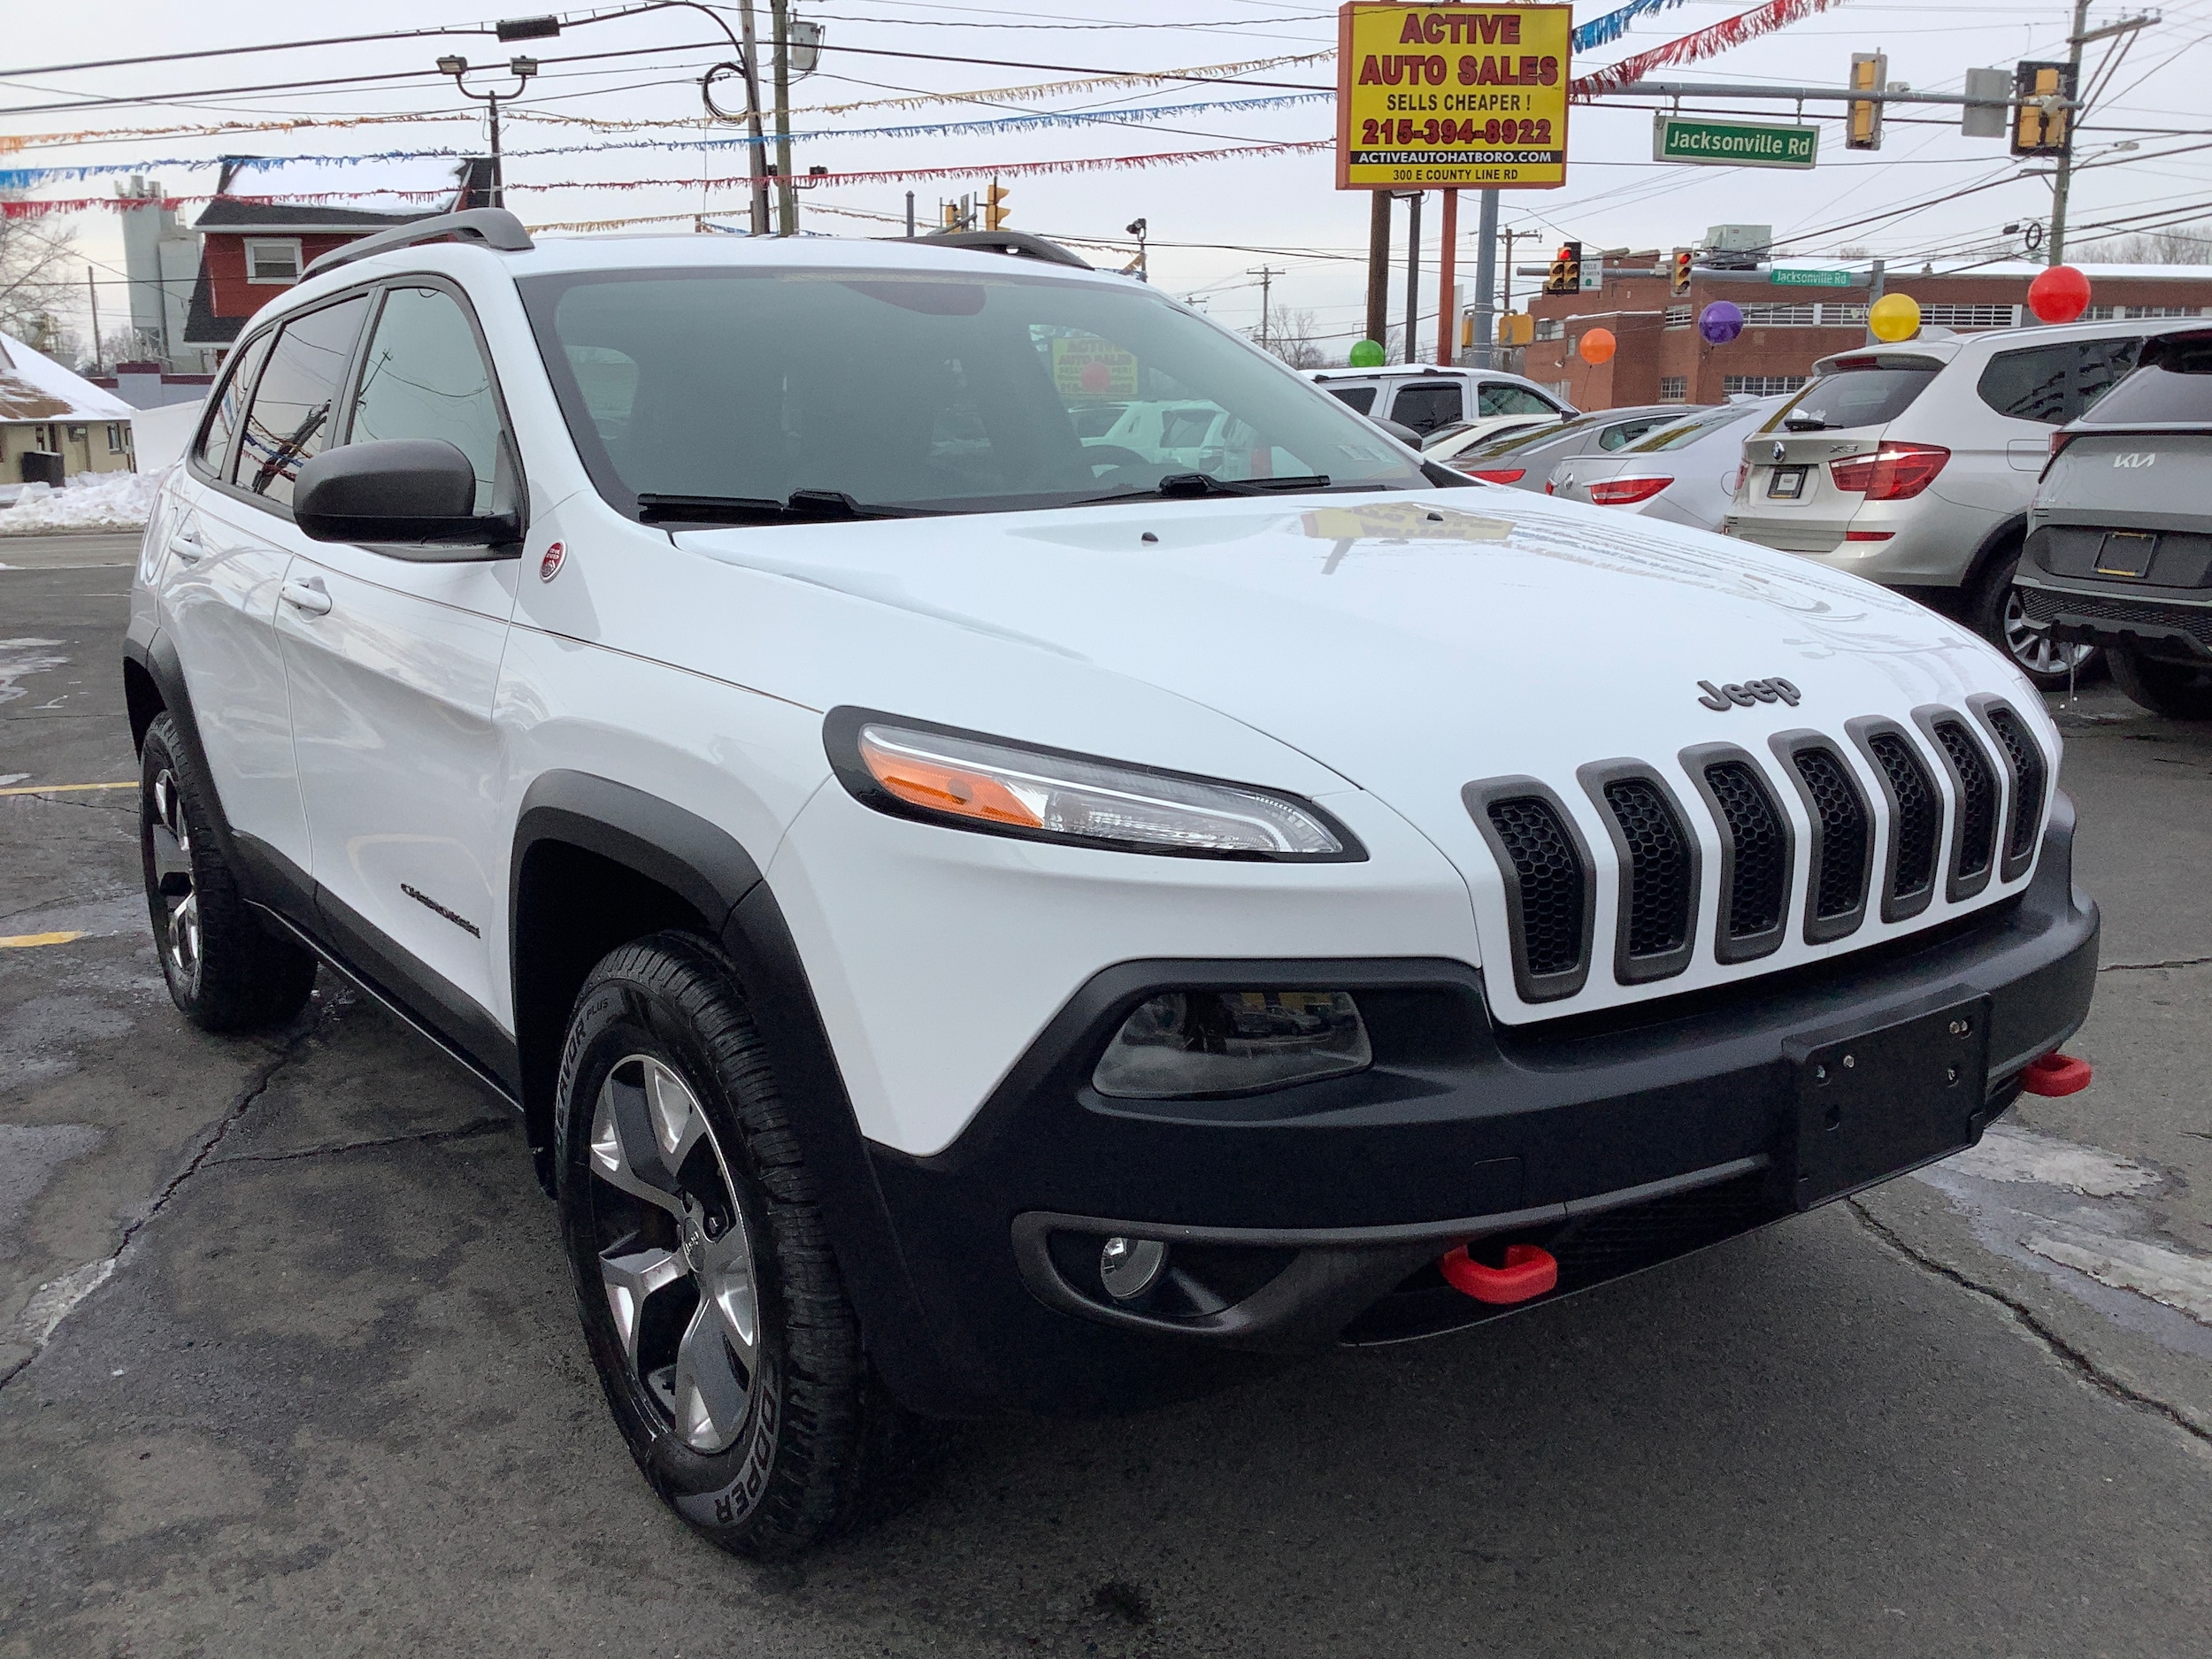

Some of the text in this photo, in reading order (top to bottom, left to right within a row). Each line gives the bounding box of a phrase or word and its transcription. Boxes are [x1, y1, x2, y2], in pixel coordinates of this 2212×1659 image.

[1399, 13, 1521, 44] ACTIVE
[1358, 55, 1558, 86] AUTO SALES
[1386, 94, 1438, 111] SELLS
[1444, 94, 1521, 111] CHEAPER
[1362, 118, 1551, 145] 215-394-8922
[1670, 130, 1810, 156] Jacksonville Rd
[1357, 151, 1551, 164] ACTIVEAUTOHATBORO.COM
[1393, 169, 1518, 180] 300 E COUNTY LINE RD
[1778, 270, 1847, 284] Jacksonville Rd
[1697, 677, 1801, 711] Jeep
[586, 998, 610, 1020] PLUS
